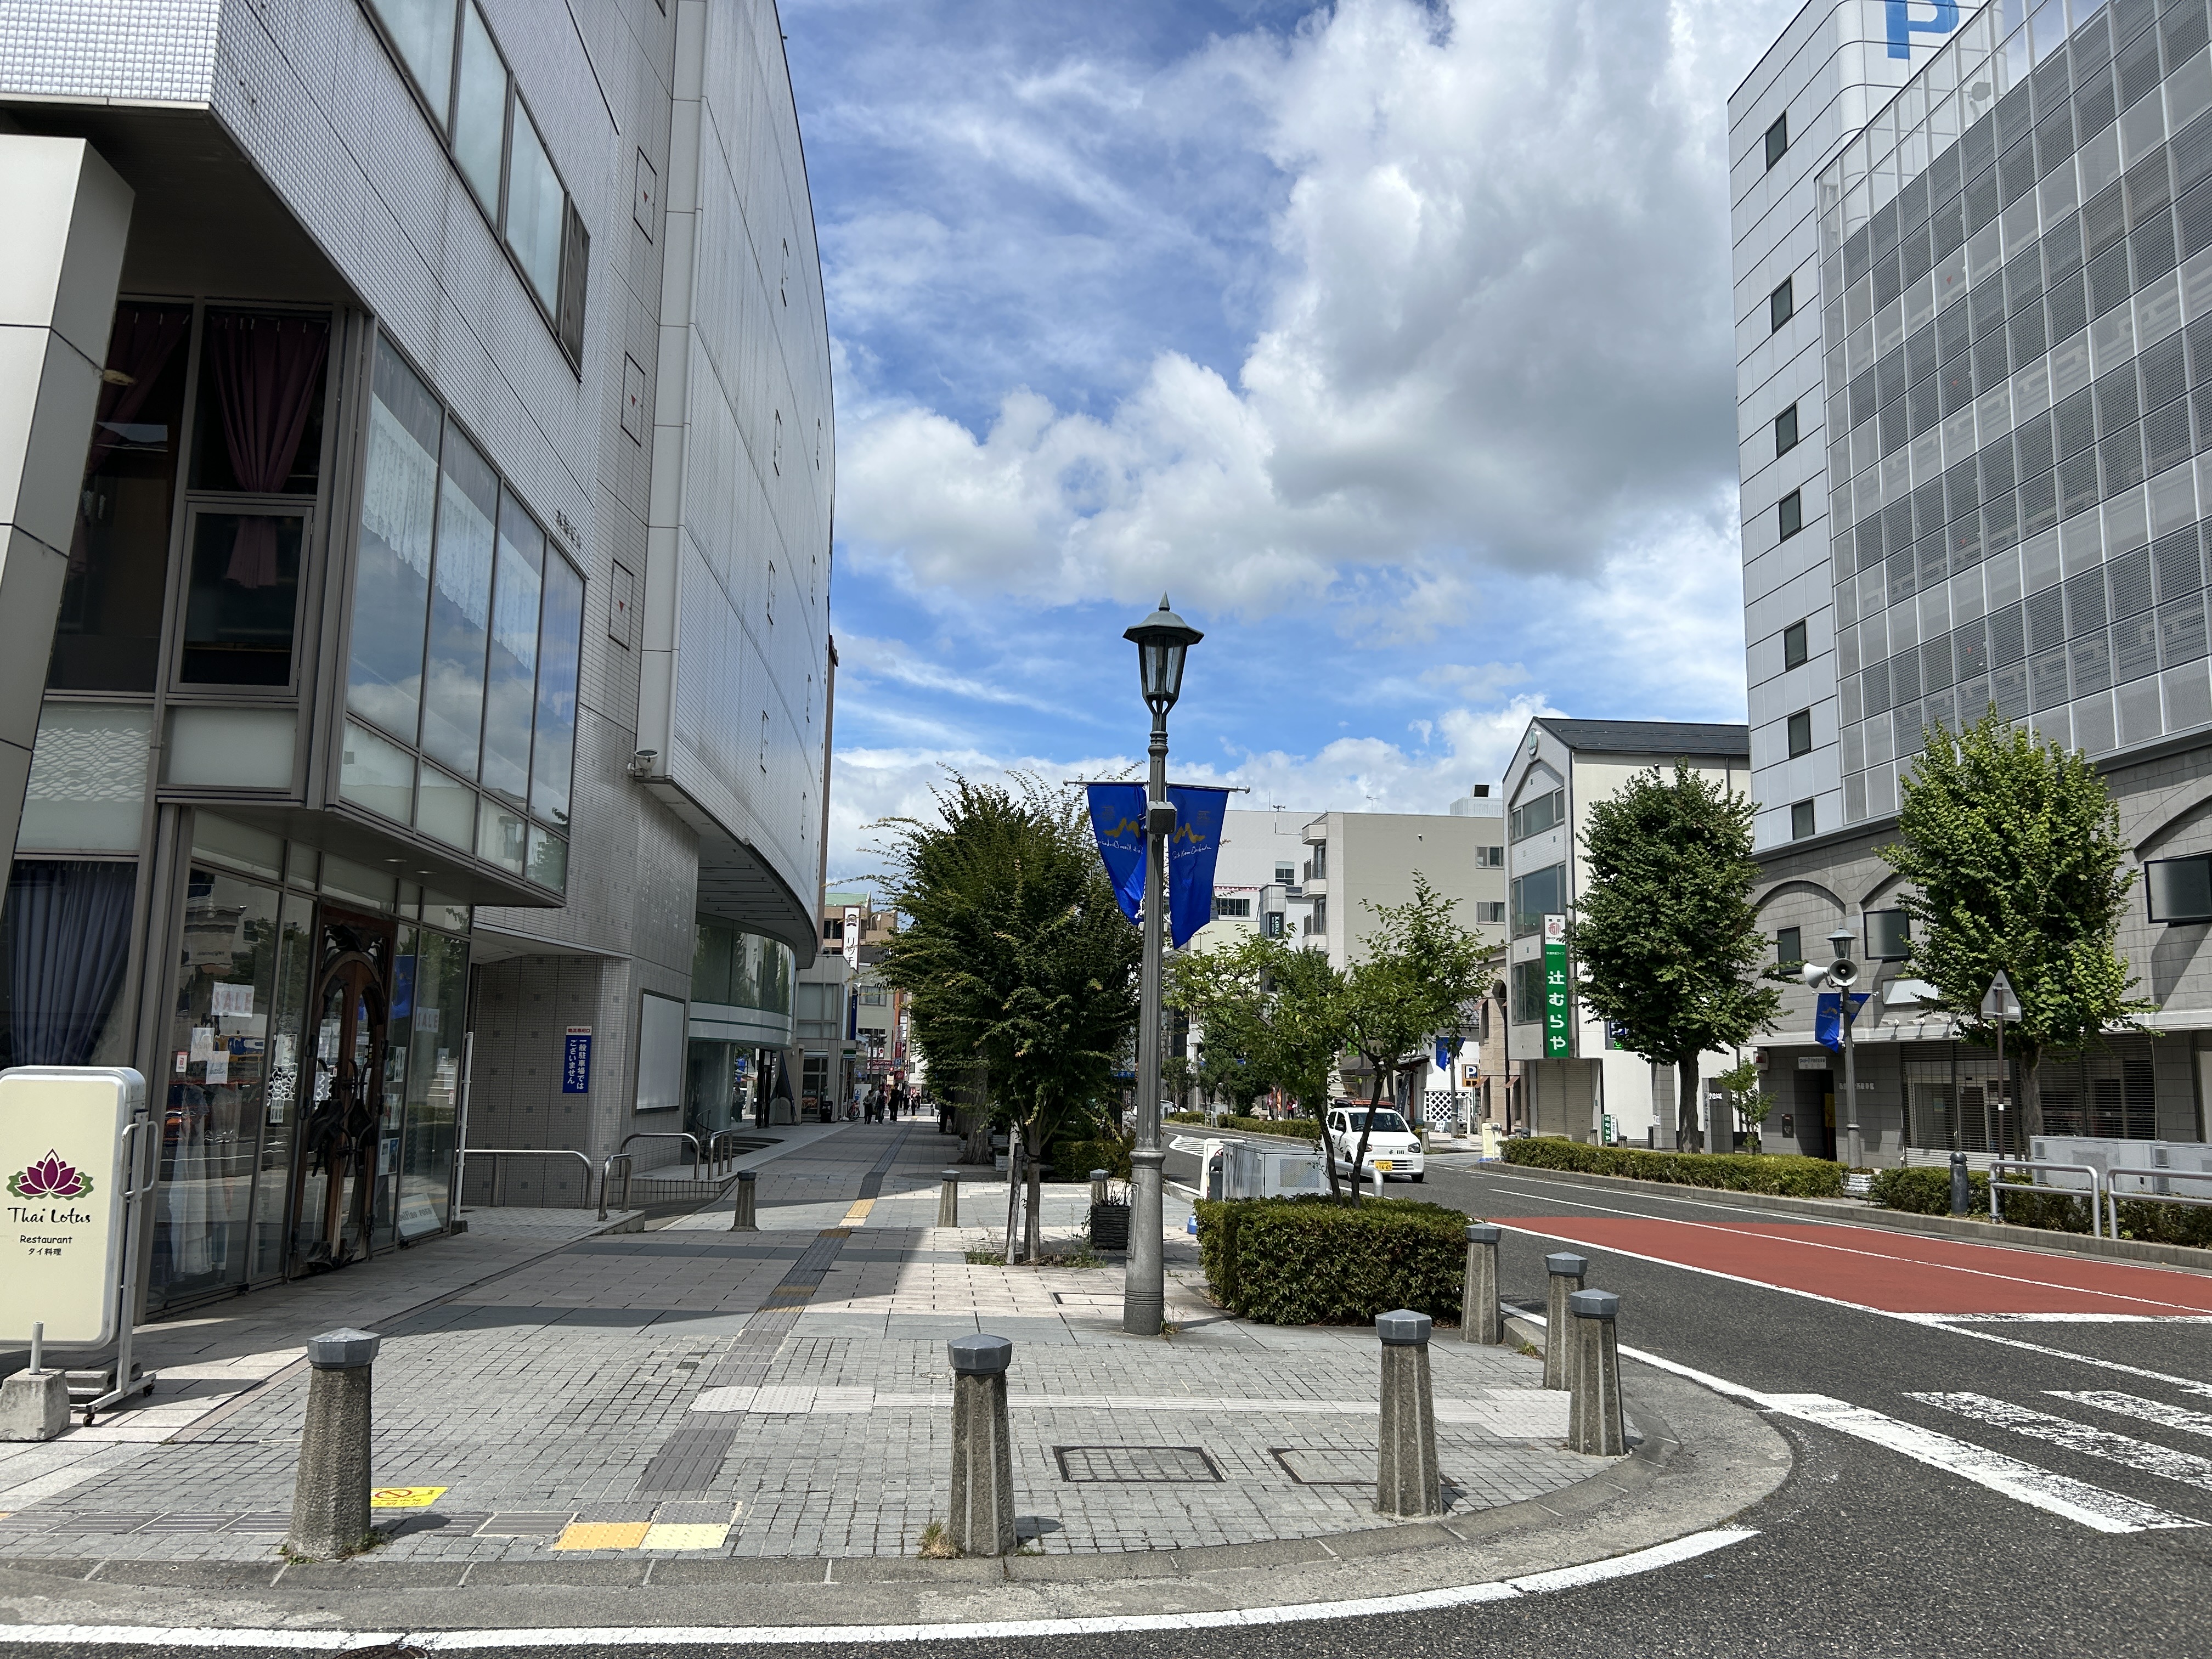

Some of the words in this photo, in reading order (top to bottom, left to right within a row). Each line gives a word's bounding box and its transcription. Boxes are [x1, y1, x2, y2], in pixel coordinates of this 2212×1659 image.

[1885, 0, 1959, 60] P
[213, 991, 252, 1011] SALE
[1547, 970, 1566, 1050] 辻むらや
[417, 1012, 438, 1028] SALE
[567, 1039, 578, 1084] ございません
[577, 1039, 587, 1090] 一般駐車場では
[1465, 1065, 1477, 1079] P
[7, 1207, 46, 1223] Thai
[51, 1207, 91, 1224] Lotus
[20, 1235, 72, 1244] Restaurant
[29, 1248, 61, 1256] タイ料理
